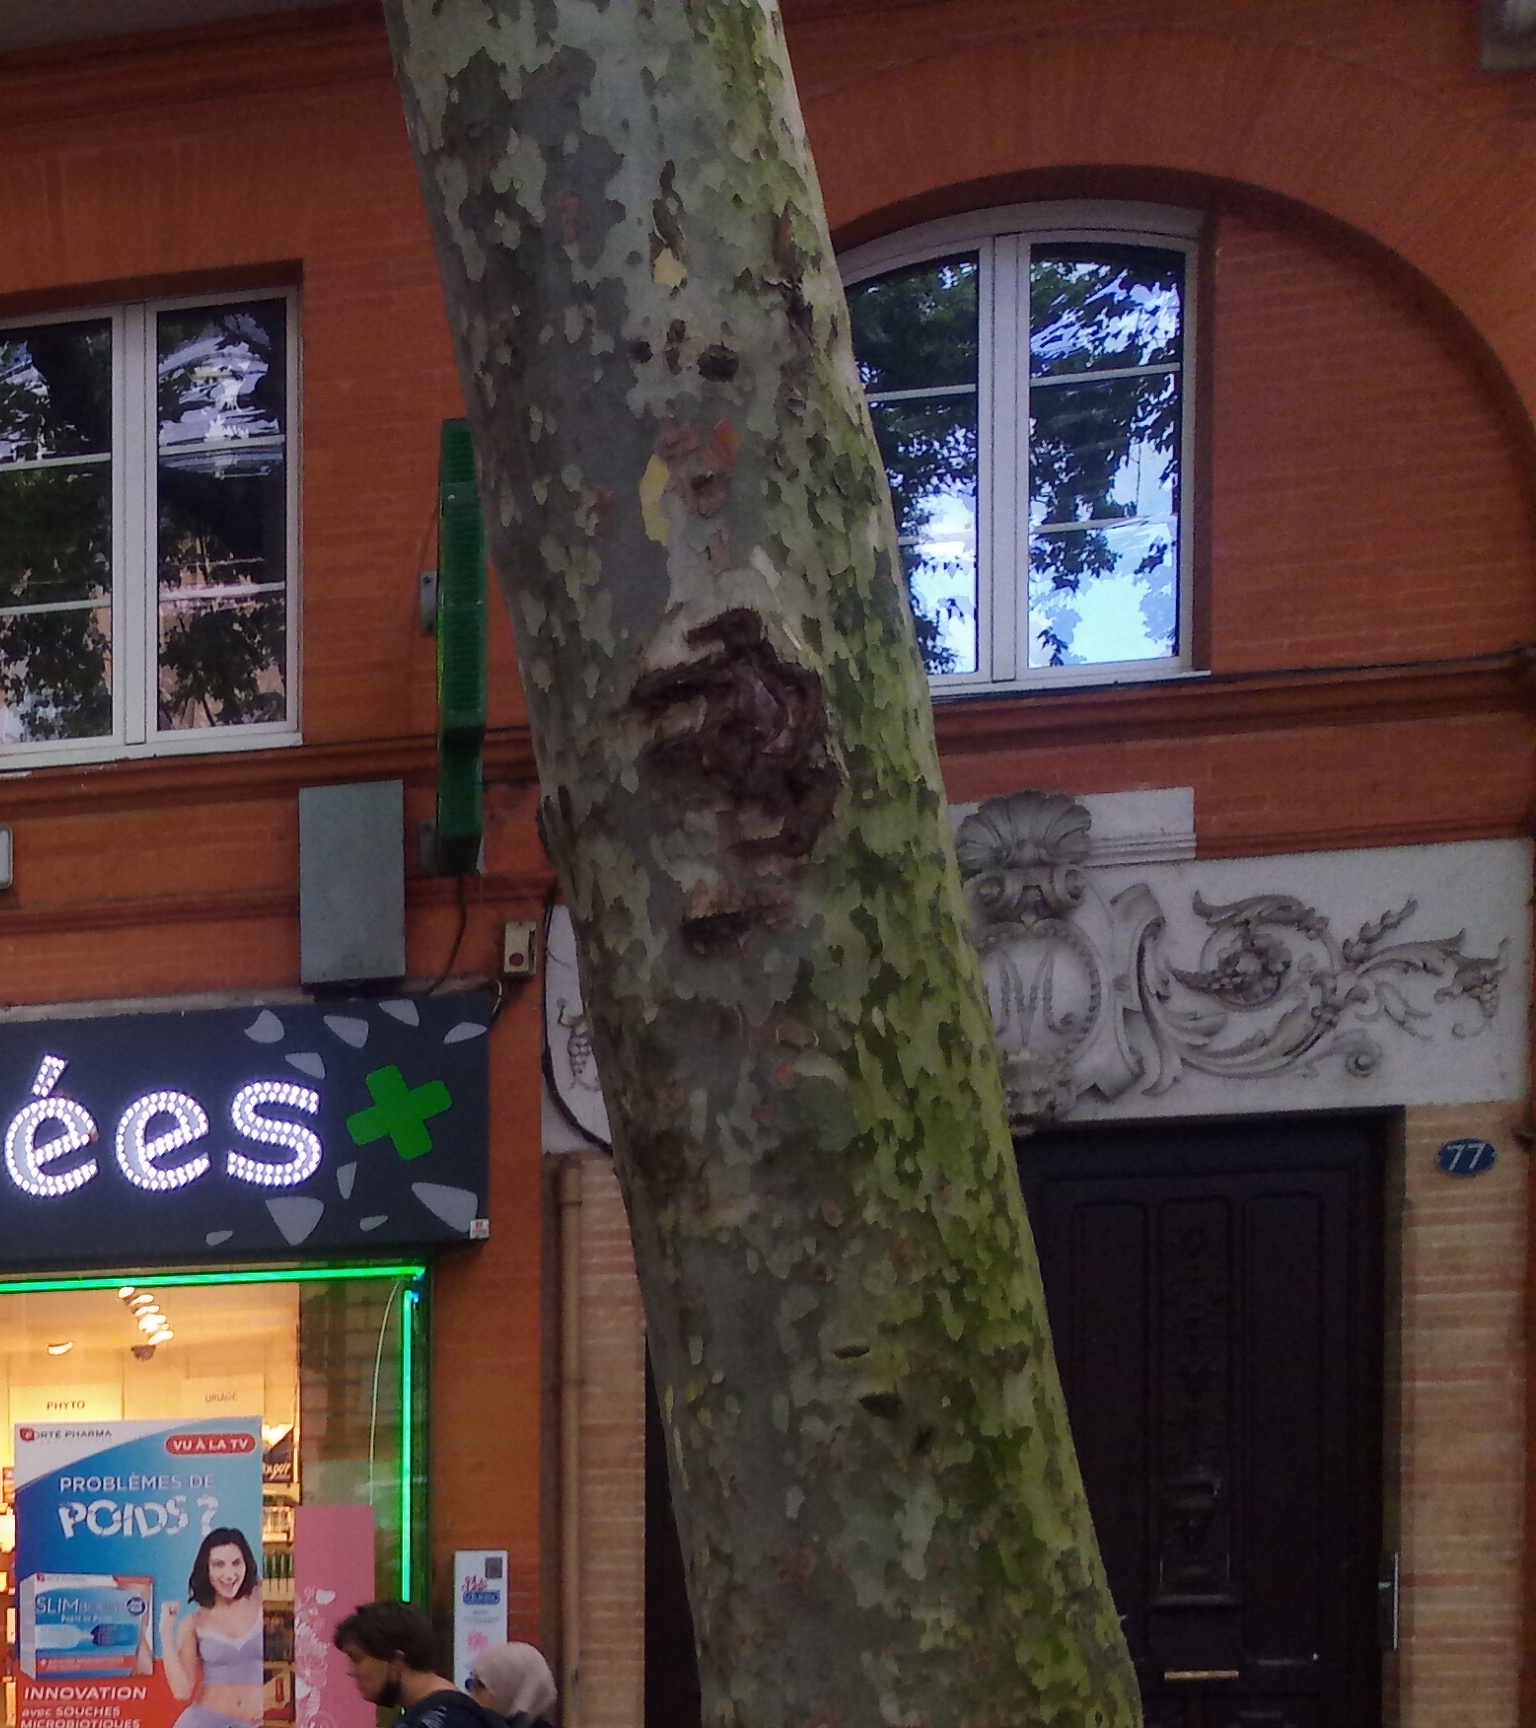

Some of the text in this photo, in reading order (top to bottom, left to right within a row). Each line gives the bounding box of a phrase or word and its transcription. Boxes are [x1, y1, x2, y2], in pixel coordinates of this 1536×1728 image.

[1446, 1142, 1487, 1171] 77
[204, 1391, 239, 1404] URIAGE
[46, 1400, 86, 1411] PHYTO
[65, 1429, 113, 1439] PHARMA
[172, 1437, 250, 1451] VU À LA TV
[59, 1472, 217, 1493] PROBLÈMES DE
[58, 1495, 189, 1540] POIDS
[23, 1686, 147, 1701] INNOVATION
[21, 1705, 121, 1718] avec SOUCHES
